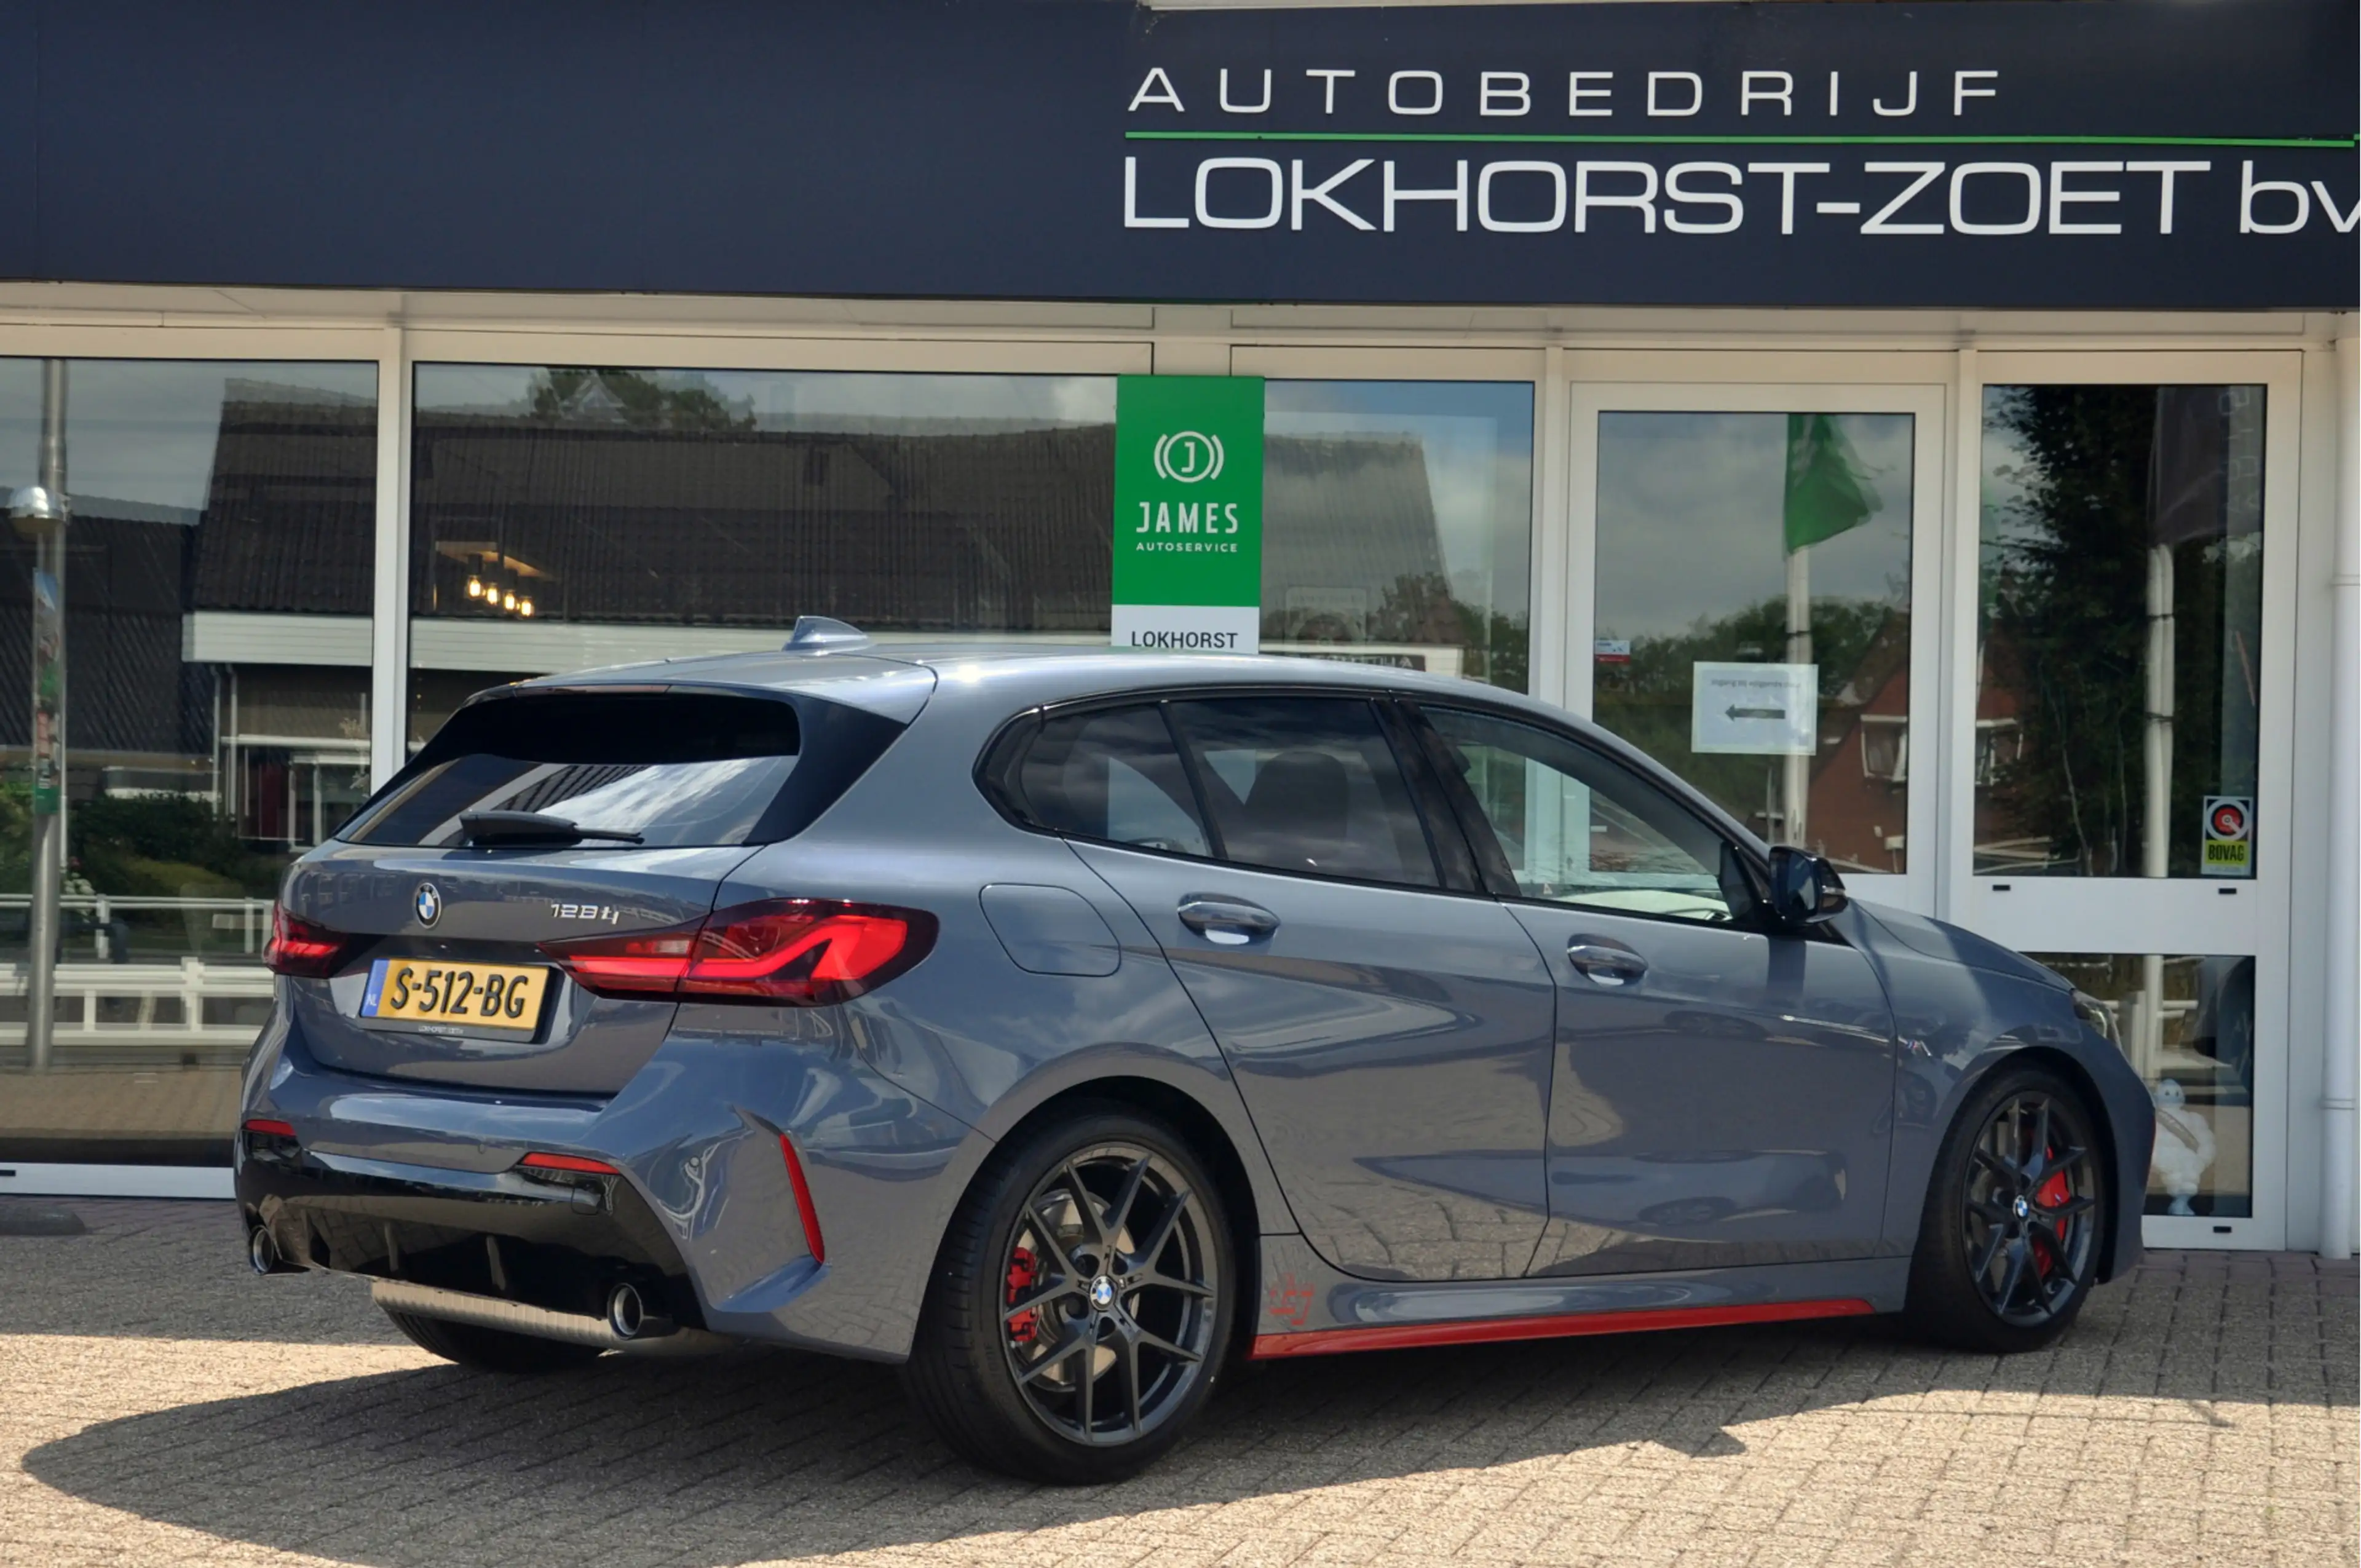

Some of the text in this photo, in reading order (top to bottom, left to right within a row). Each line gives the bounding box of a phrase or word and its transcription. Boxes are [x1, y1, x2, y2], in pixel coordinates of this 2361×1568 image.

[1128, 68, 1998, 117] AUTOBEDRIJF
[1124, 156, 2360, 235] LOKHORST-ZOET bv
[1136, 502, 1238, 534] JAMES
[1136, 542, 1238, 553] AUTOSERVICE
[1131, 630, 1238, 649] LOKHORST
[2208, 844, 2244, 861] BOVAG
[390, 966, 529, 1019] S-512-BG
